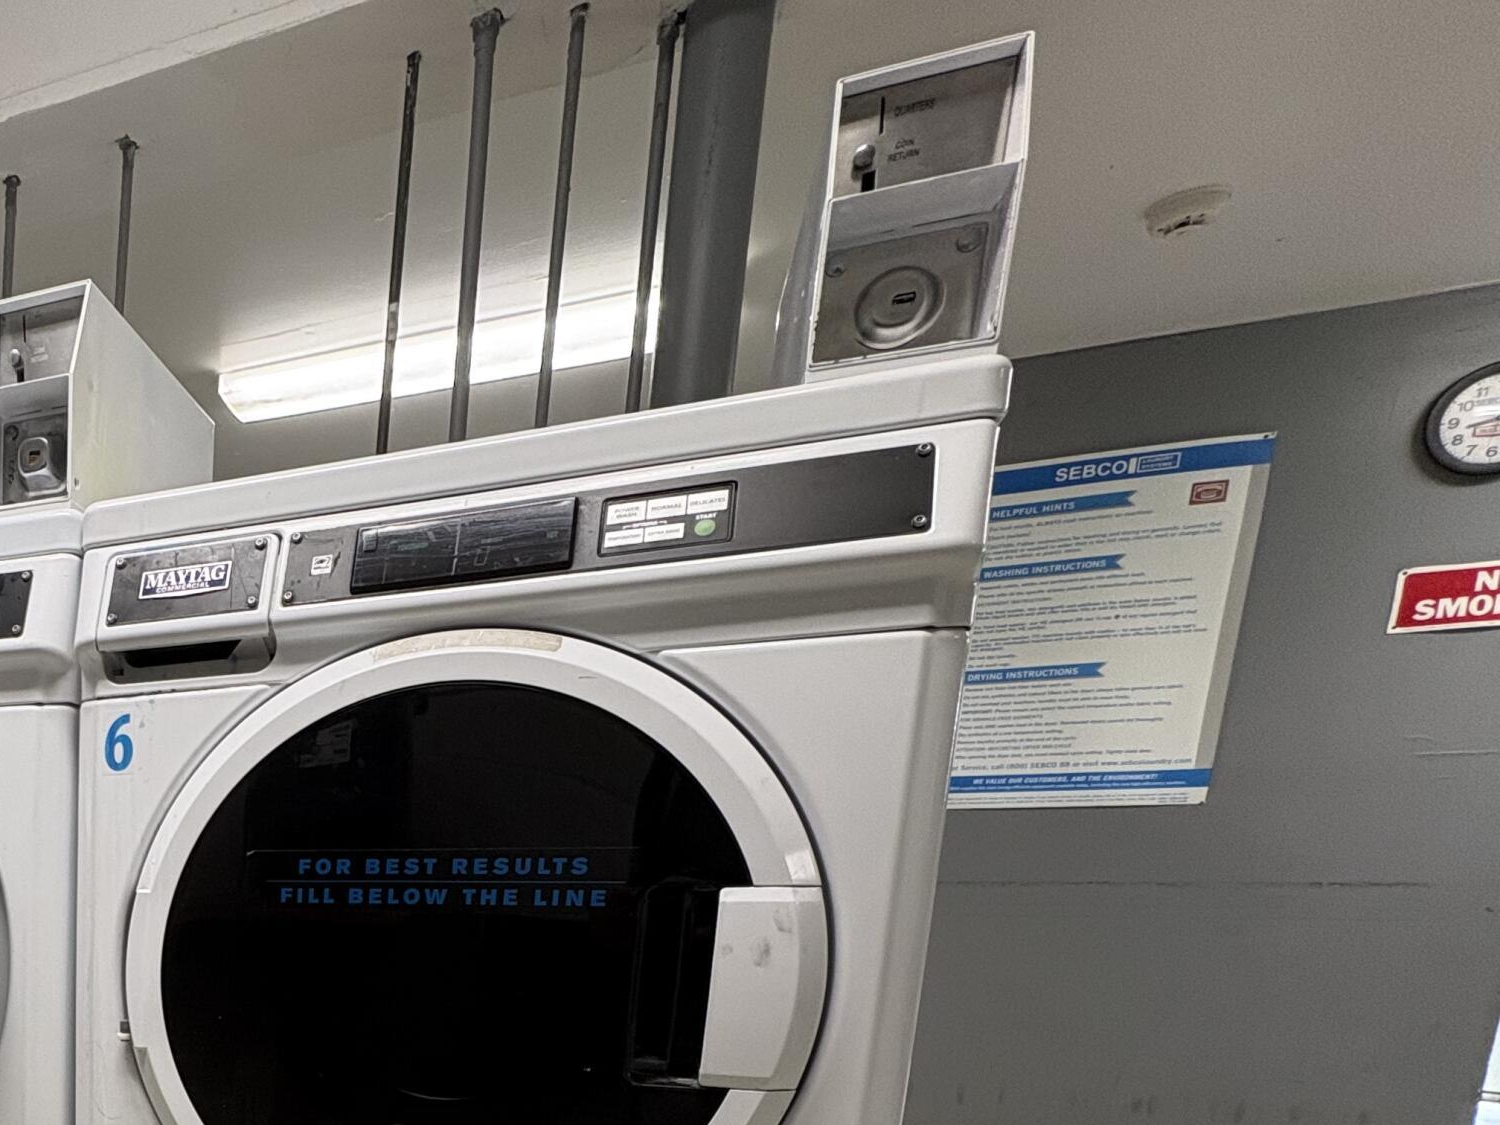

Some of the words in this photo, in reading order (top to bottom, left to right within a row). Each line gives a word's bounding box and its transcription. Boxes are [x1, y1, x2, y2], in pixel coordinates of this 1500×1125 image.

[1476, 387, 1489, 398] 11
[1457, 400, 1474, 412] 10
[1447, 417, 1460, 430] 9
[1451, 434, 1463, 446] 8
[1465, 444, 1478, 456] 7
[1485, 446, 1498, 457] 6
[1055, 460, 1128, 482] SEBCO
[992, 507, 1038, 519] HELPFUL
[1041, 502, 1076, 513] HINTS
[145, 564, 226, 590] MAYTAG
[983, 567, 1029, 579] WASHING
[1031, 560, 1106, 574] INSTRUCTIONS
[155, 581, 210, 594] COMMERCIAL
[967, 672, 1004, 682] DRYING
[1006, 667, 1079, 679] INSTRUCTIONS
[104, 713, 134, 772] 6
[299, 859, 351, 875] FOR
[365, 858, 438, 875] BEST
[452, 857, 589, 875] RESULTS
[280, 888, 334, 904] FILL
[348, 888, 448, 905] BELOW
[463, 888, 518, 906] THE
[534, 889, 607, 907] LINE
